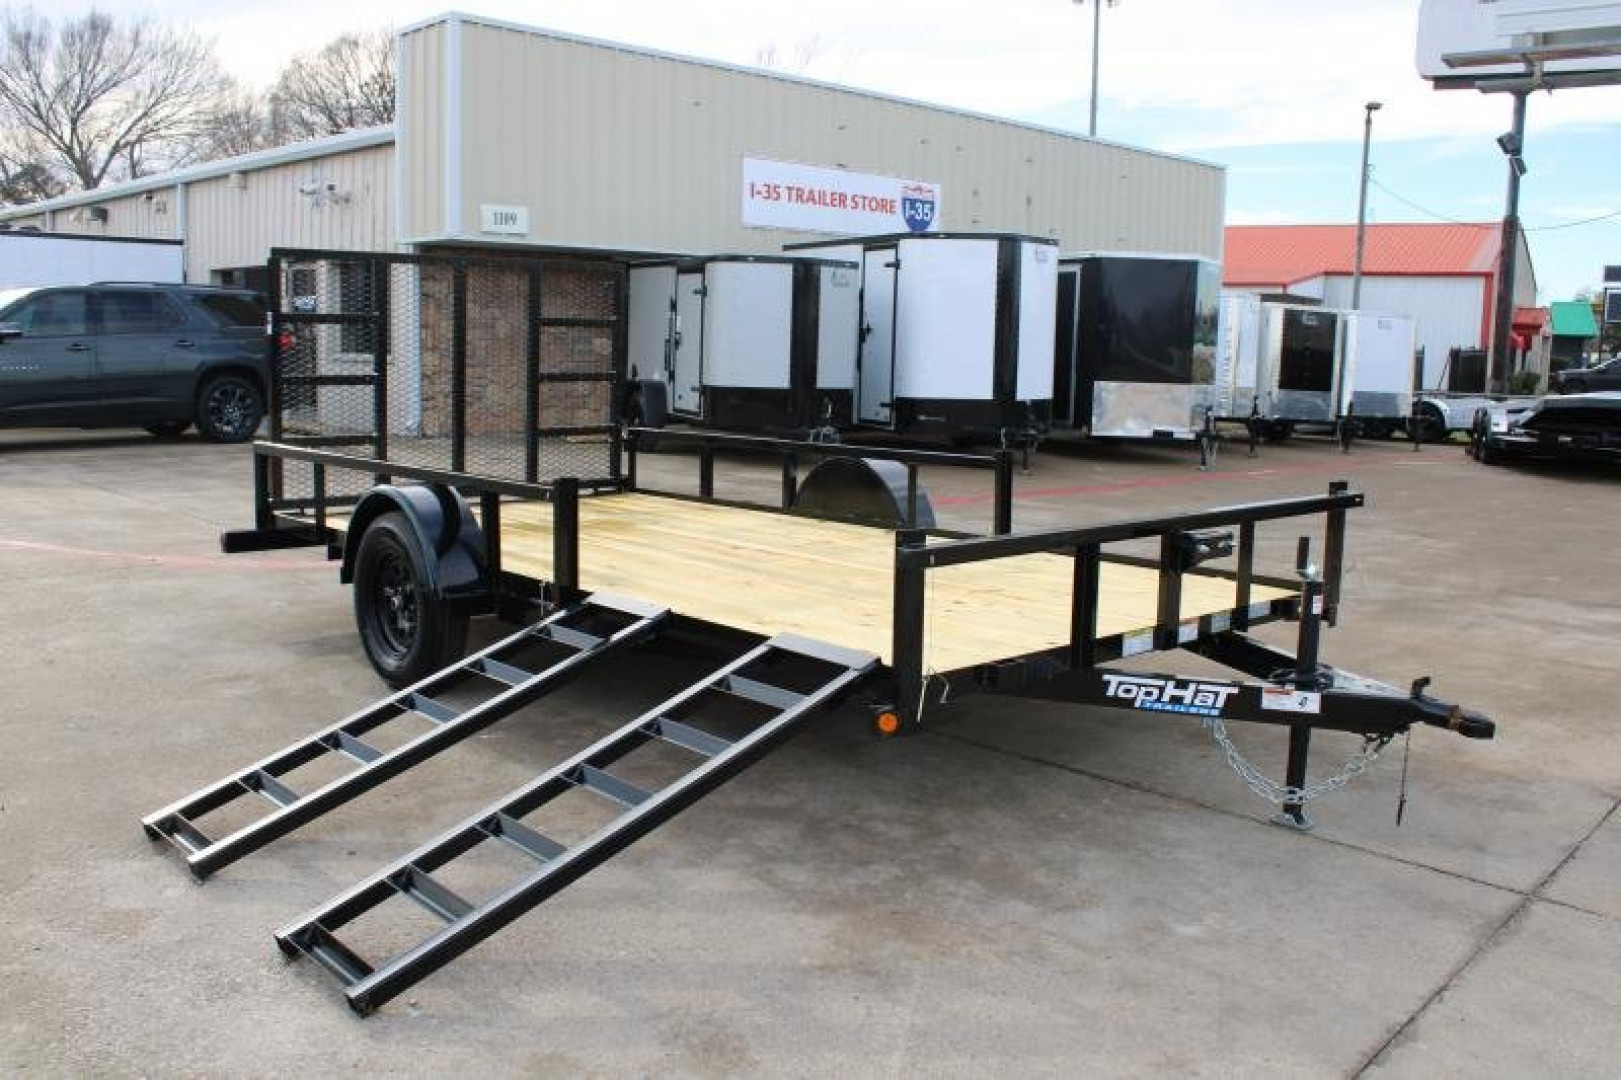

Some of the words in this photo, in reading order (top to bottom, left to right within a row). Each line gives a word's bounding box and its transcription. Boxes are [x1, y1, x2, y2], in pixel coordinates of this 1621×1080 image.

[750, 181, 781, 201] I-35
[786, 185, 848, 210] TRAILER
[850, 193, 897, 215] STORE
[905, 200, 932, 221] I-35
